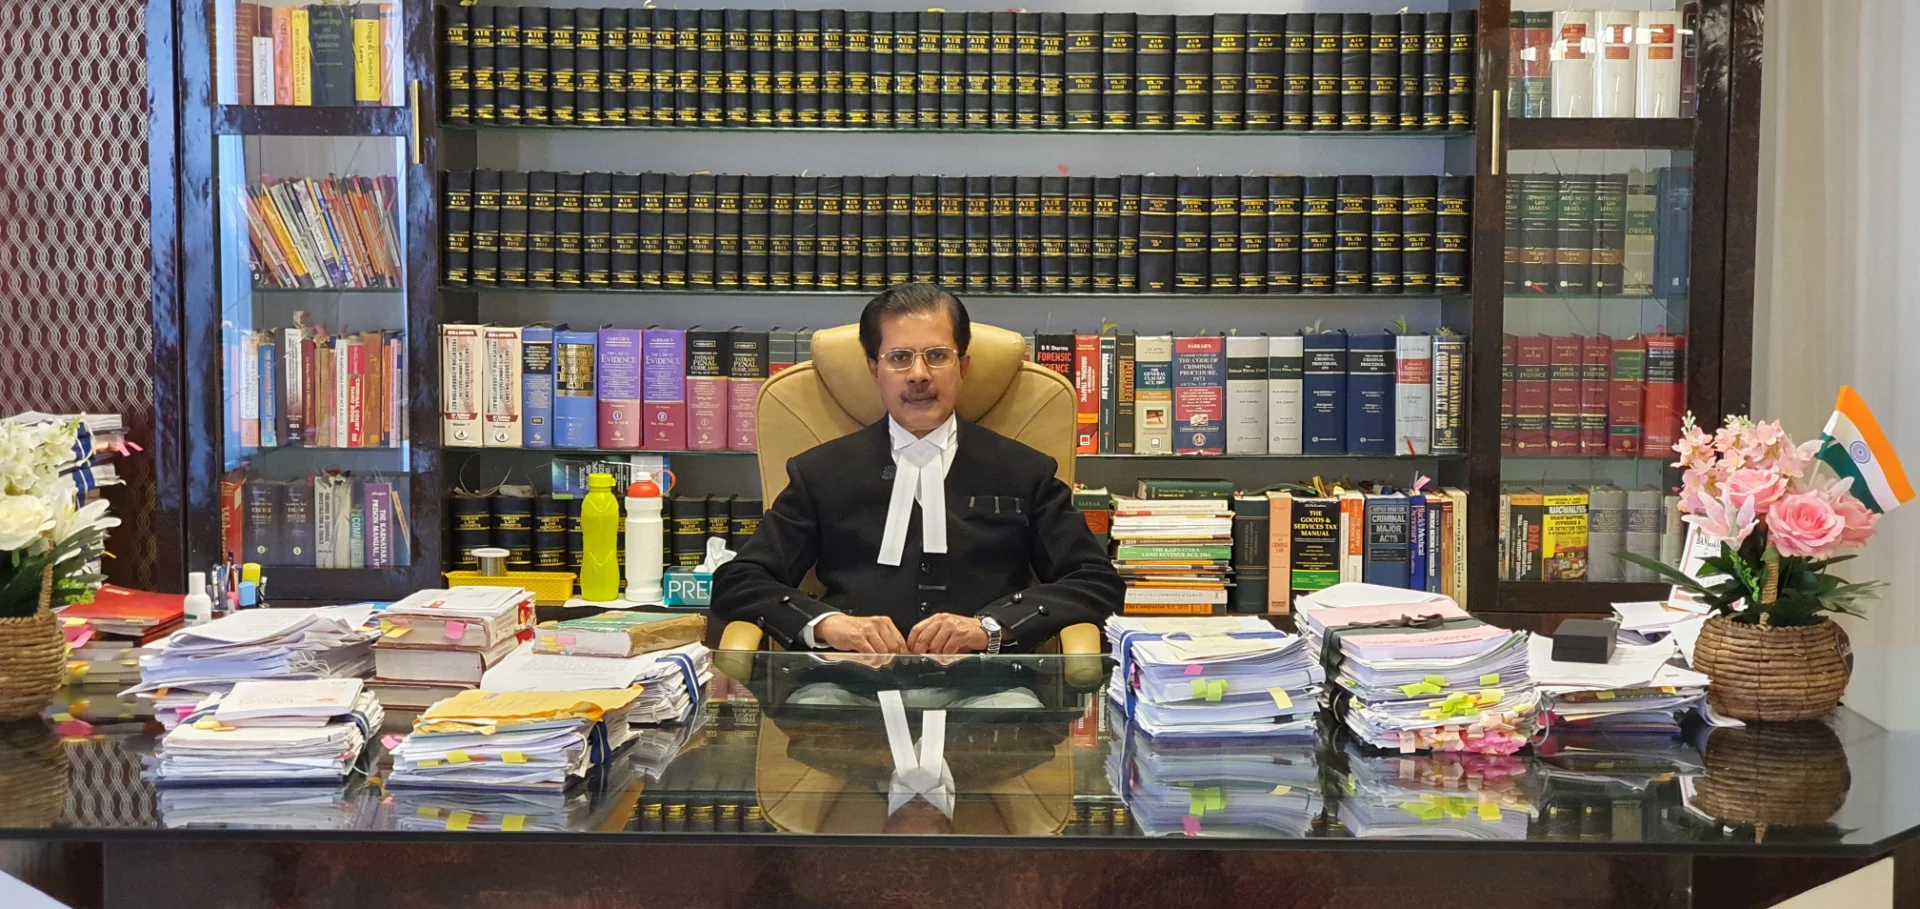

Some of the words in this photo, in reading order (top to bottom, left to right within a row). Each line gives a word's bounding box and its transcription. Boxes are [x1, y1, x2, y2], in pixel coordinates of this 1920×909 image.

[366, 21, 374, 43] Drugs
[367, 52, 375, 88] Cosmetics
[1037, 352, 1072, 362] FORENSIC
[1450, 355, 1462, 369] THE
[1436, 352, 1449, 396] CORRUPTION
[1450, 370, 1462, 416] PREVENTION
[1436, 414, 1448, 429] 1988
[1449, 418, 1460, 427] OF
[1528, 525, 1540, 552] DNA
[668, 580, 712, 599] PRE
